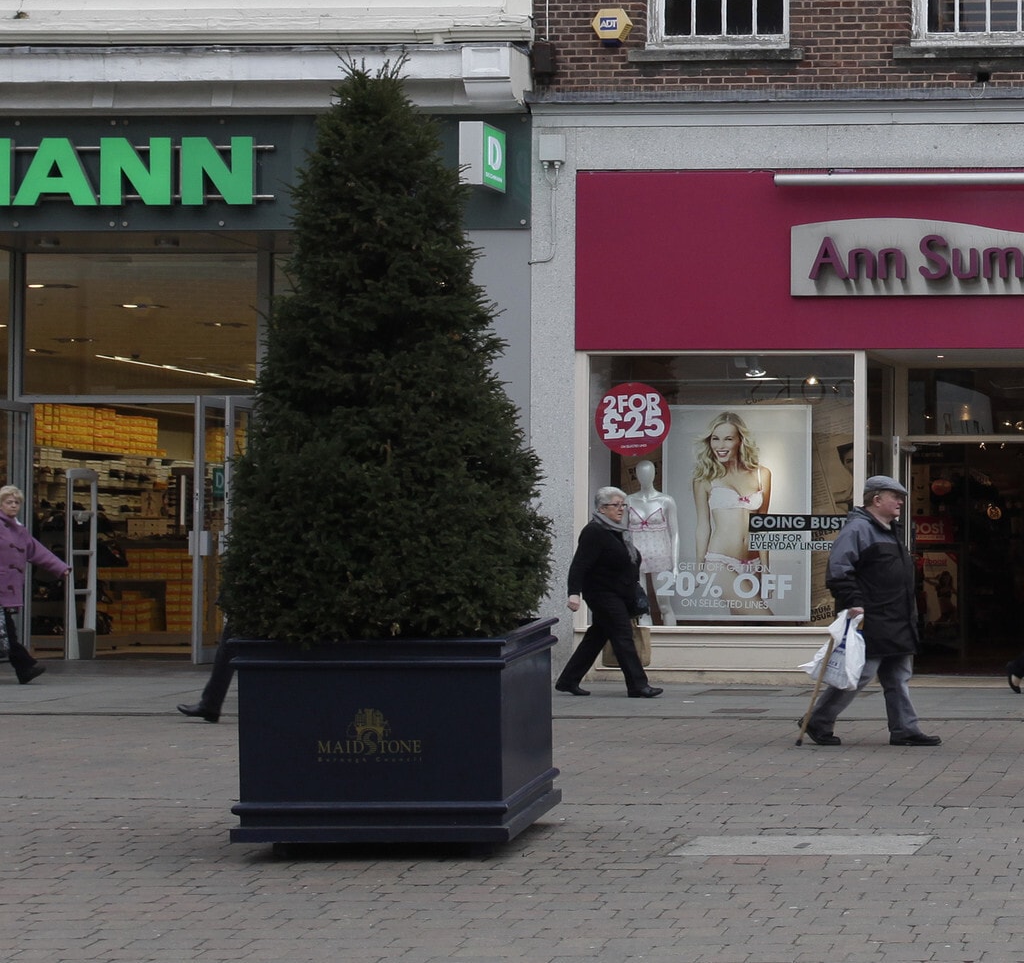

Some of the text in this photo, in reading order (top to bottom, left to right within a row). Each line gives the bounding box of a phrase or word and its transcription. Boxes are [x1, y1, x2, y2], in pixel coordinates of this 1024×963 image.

[600, 19, 617, 28] ADT
[487, 135, 503, 171] D
[0, 136, 253, 206] ANN
[808, 235, 906, 281] Ann
[602, 409, 665, 439] £25
[750, 515, 848, 529] GOING BUST
[750, 534, 802, 542] TRY US FOR
[750, 541, 798, 550] EVERYDAY
[678, 562, 696, 571] GET
[698, 562, 705, 571] IT
[706, 562, 724, 571] OFF
[755, 564, 771, 573] ON
[656, 571, 793, 600] 20% OFF
[681, 598, 769, 610] ON SELECTED LINES
[317, 739, 422, 755] MAIDSTONE
